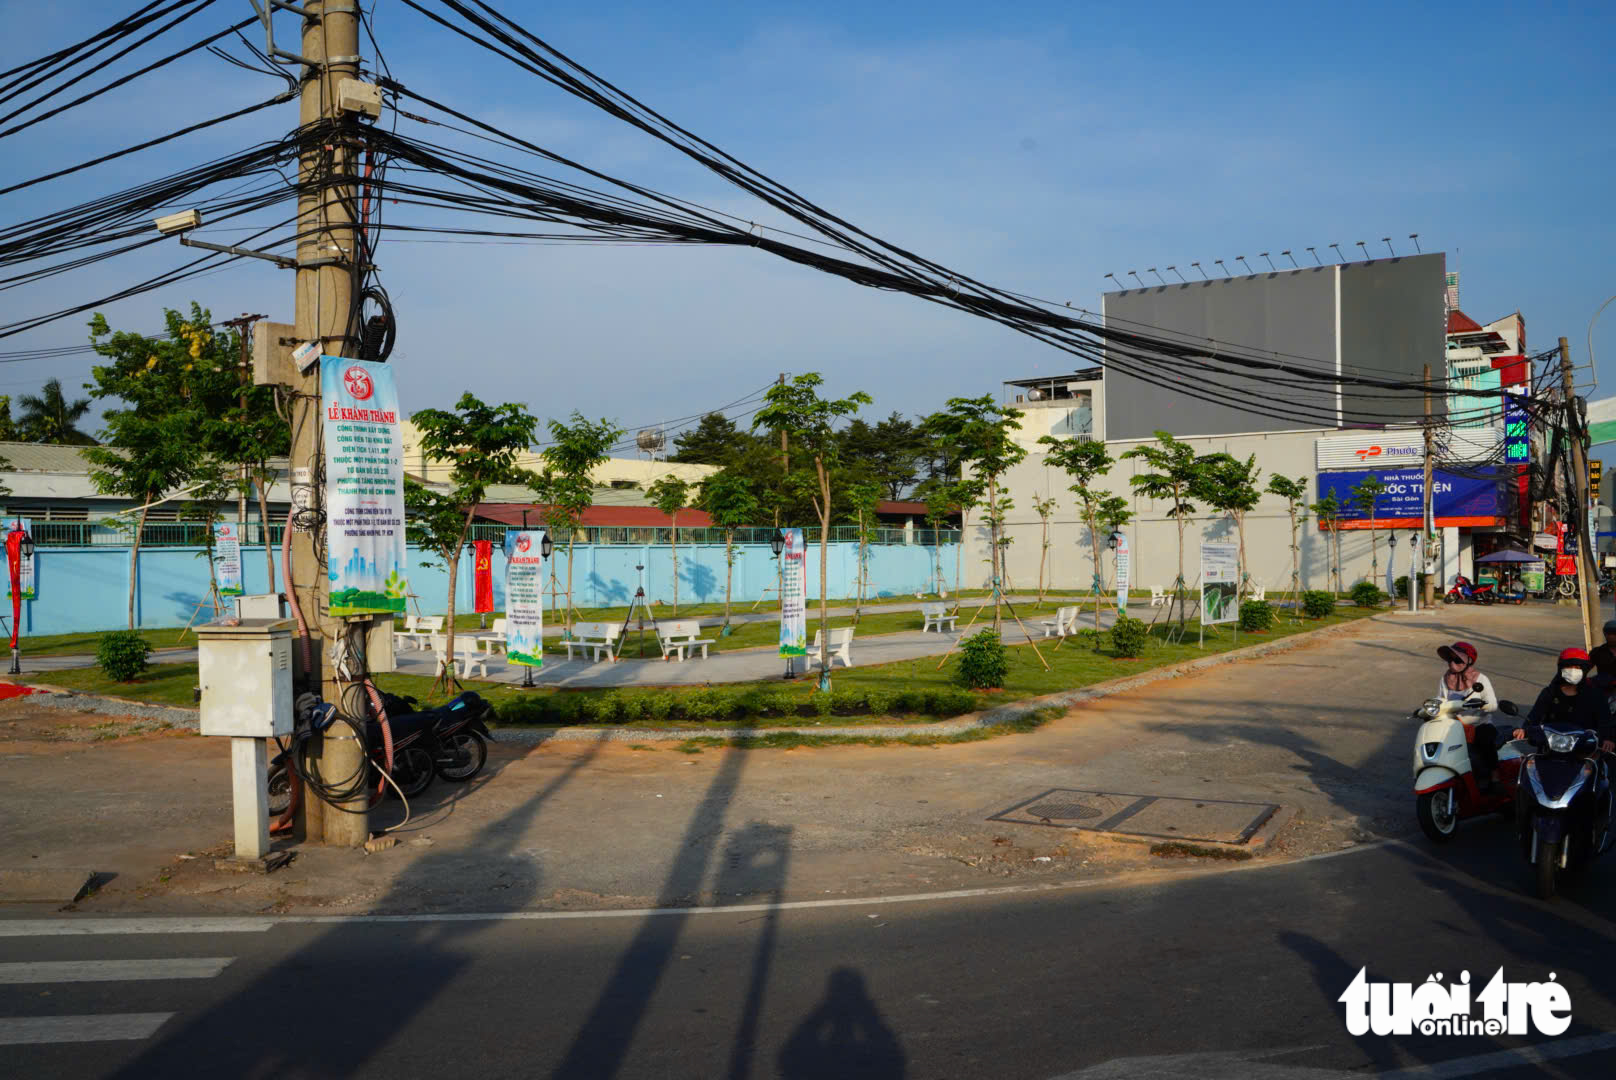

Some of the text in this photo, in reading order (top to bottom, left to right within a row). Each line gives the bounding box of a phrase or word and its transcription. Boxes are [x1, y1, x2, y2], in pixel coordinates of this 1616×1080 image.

[328, 401, 395, 424] LỄ KHÁNH THÀNH
[1386, 446, 1417, 456] Phước
